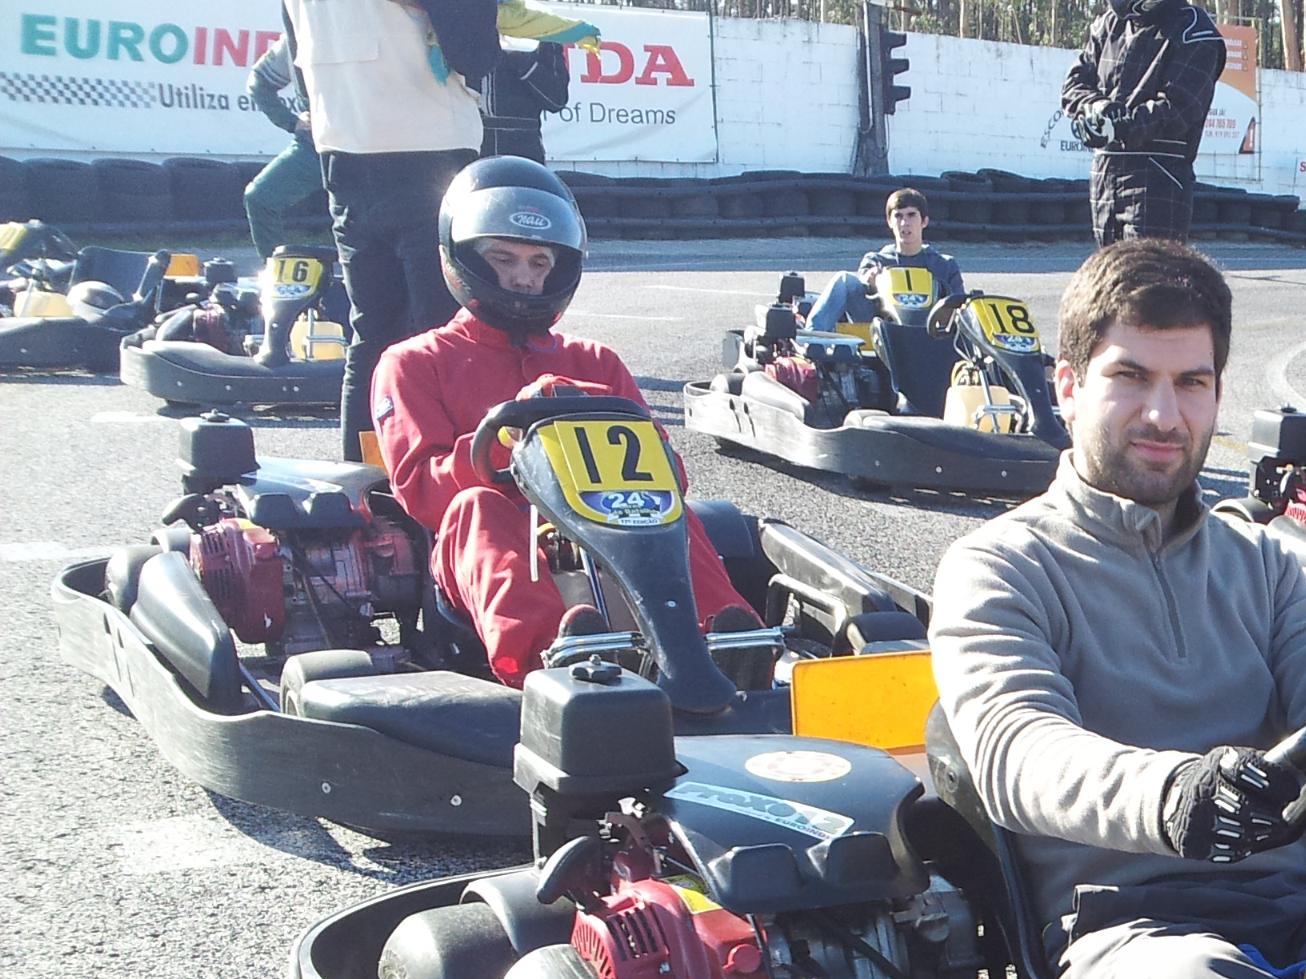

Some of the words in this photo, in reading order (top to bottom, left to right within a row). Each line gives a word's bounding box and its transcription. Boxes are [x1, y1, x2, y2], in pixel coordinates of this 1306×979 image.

[159, 83, 230, 110] Utiliza
[559, 102, 582, 122] of
[589, 102, 676, 125] Dreams
[276, 260, 309, 283] 16
[905, 270, 912, 291] 1
[988, 303, 1035, 334] 18
[574, 426, 654, 484] 12
[608, 492, 645, 509] 24
